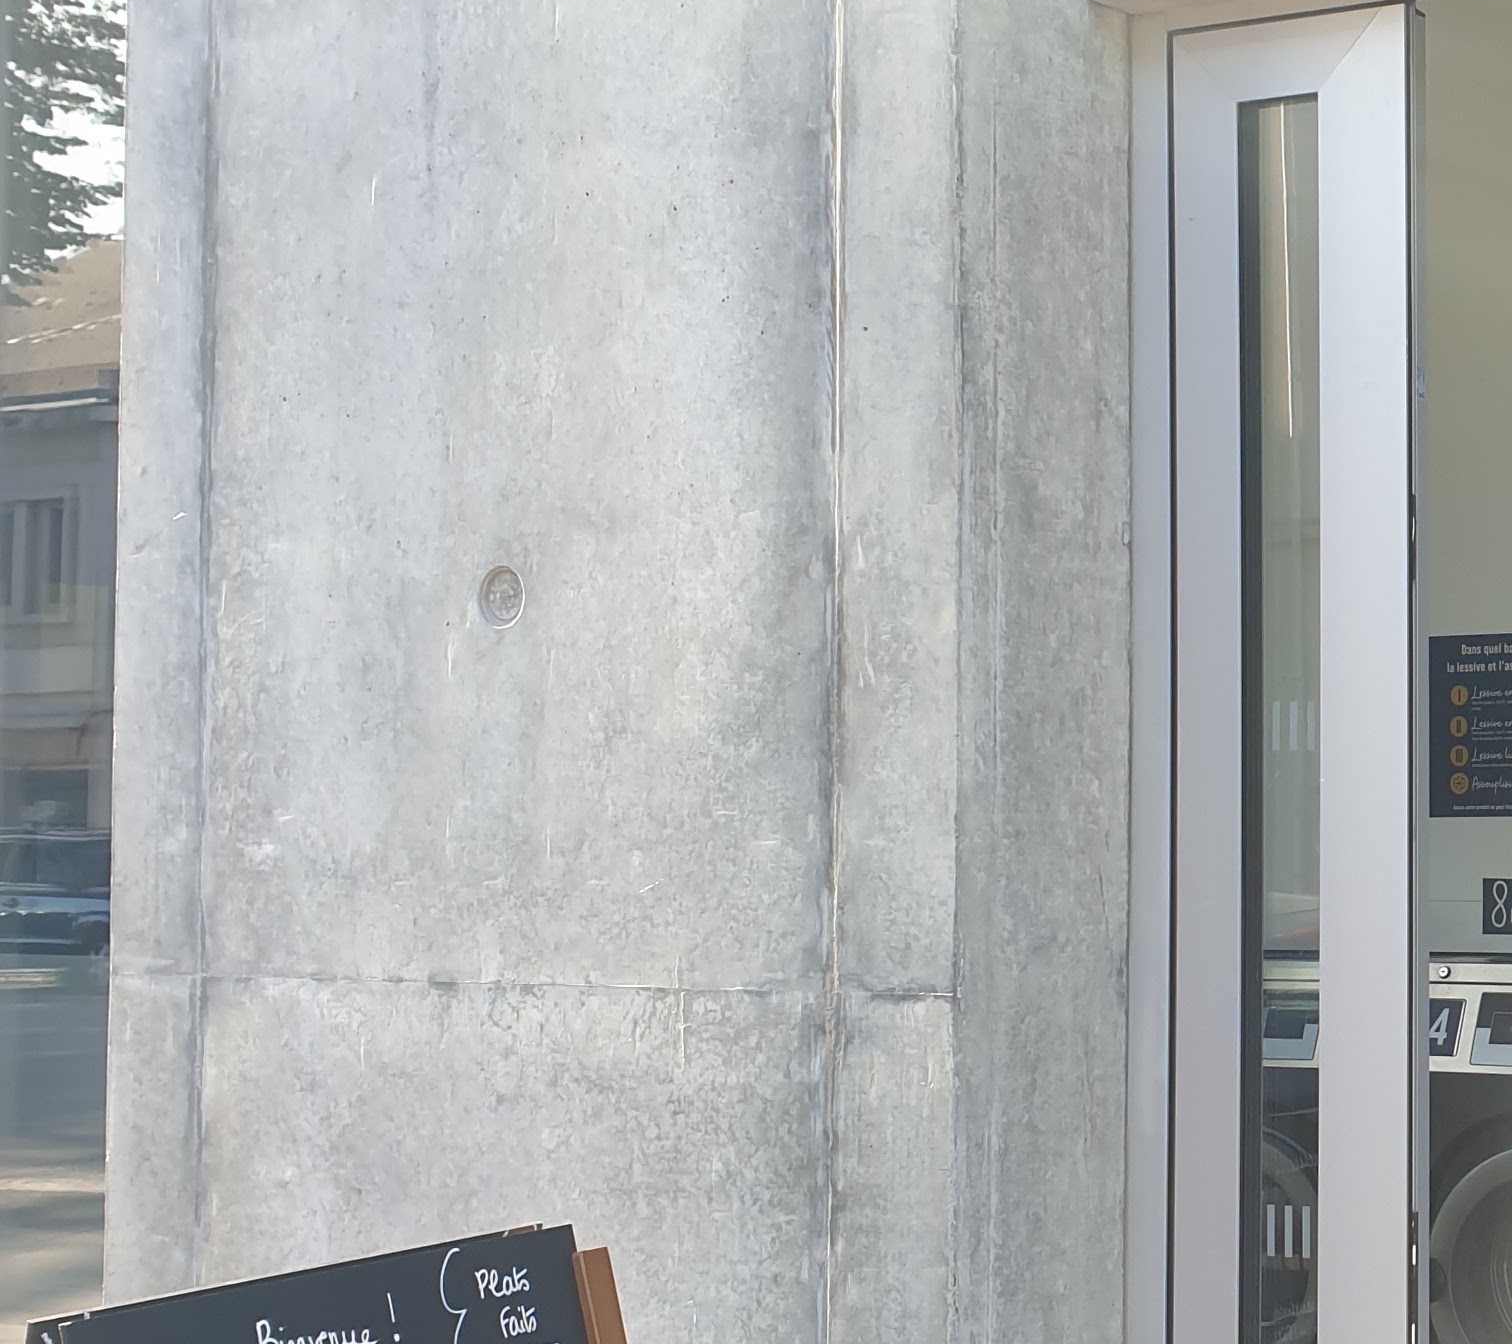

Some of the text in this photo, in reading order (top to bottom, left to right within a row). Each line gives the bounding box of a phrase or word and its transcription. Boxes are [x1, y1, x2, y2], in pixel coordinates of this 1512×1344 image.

[1447, 662, 1455, 673] la
[1457, 661, 1486, 673] lessive
[1487, 661, 1497, 672] et
[1461, 643, 1482, 656] Dans
[1483, 642, 1501, 657] quel
[1490, 880, 1508, 929] 8
[1429, 1007, 1449, 1046] 4
[475, 1266, 531, 1301] Plats
